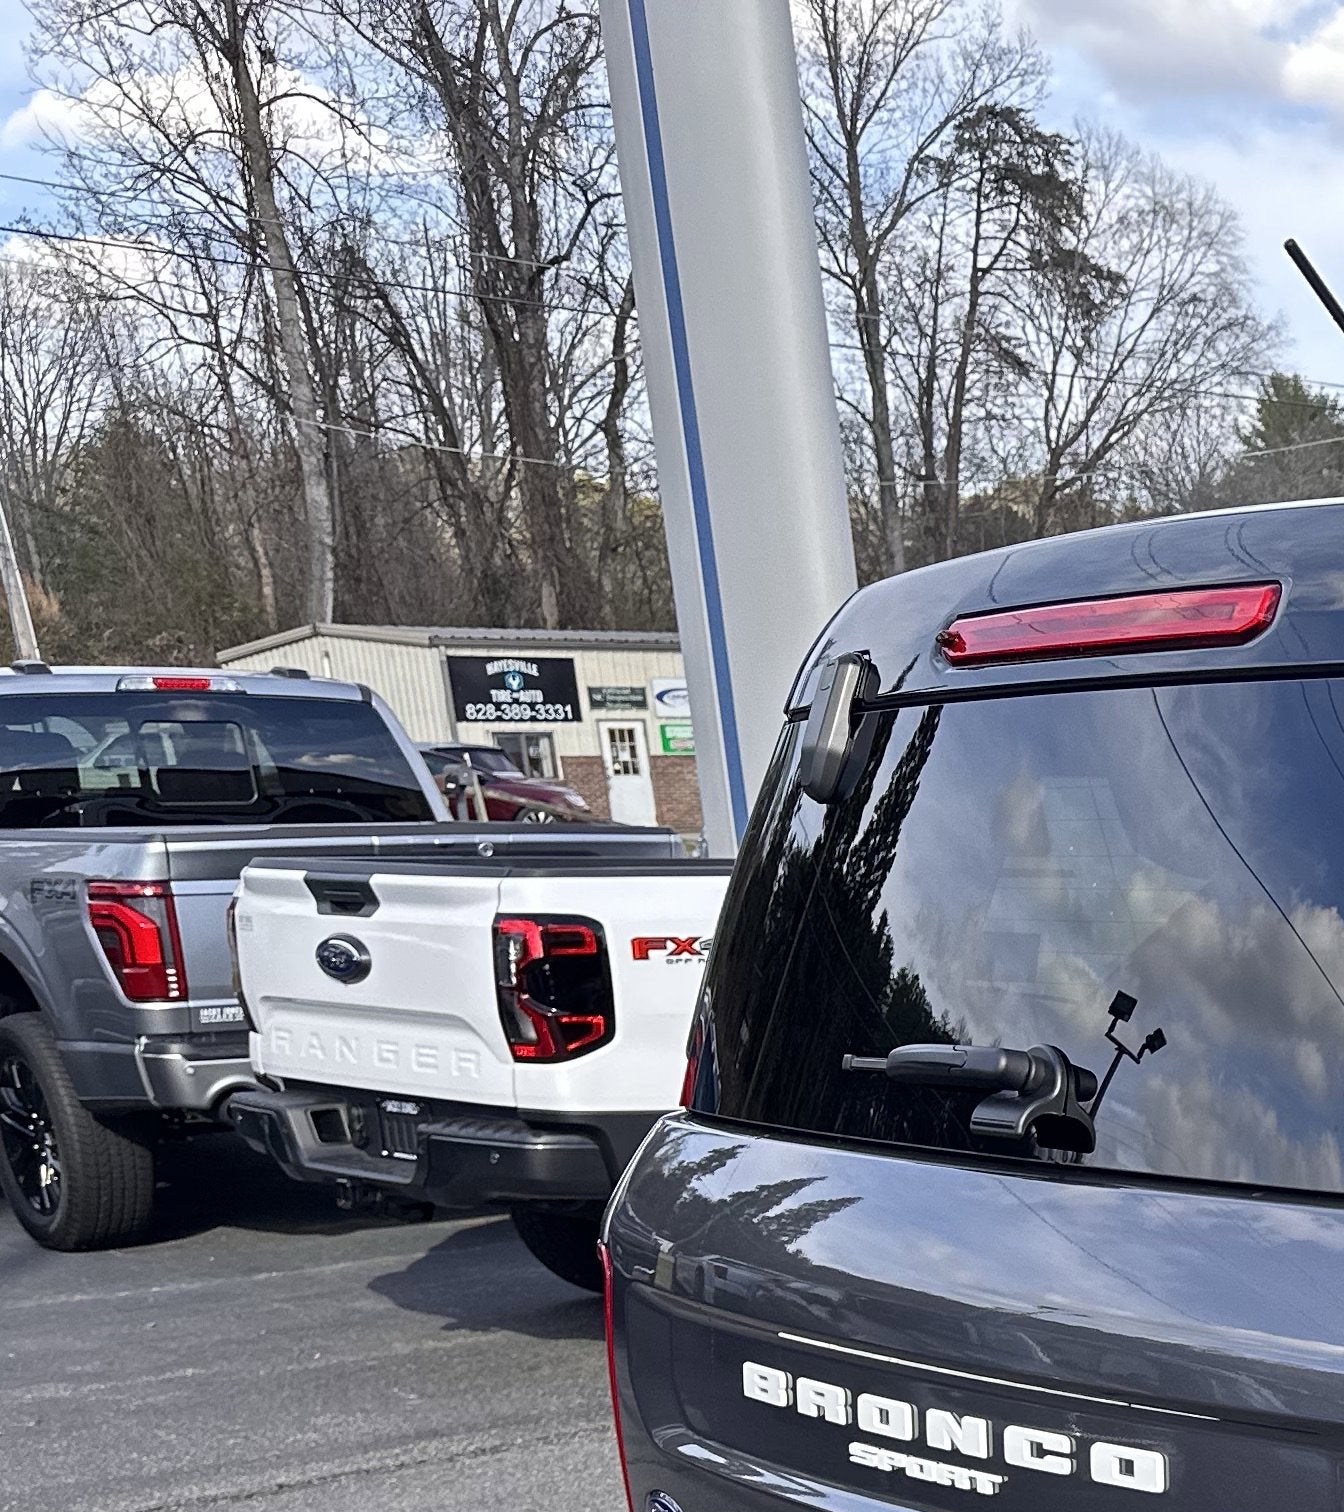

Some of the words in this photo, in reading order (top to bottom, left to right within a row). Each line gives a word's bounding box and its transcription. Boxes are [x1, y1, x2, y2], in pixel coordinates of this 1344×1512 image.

[465, 702, 573, 720] 828-389-3331
[270, 1026, 481, 1078] RANGER
[742, 1360, 1170, 1494] BRONCO
[848, 1441, 1008, 1496] SPORT
